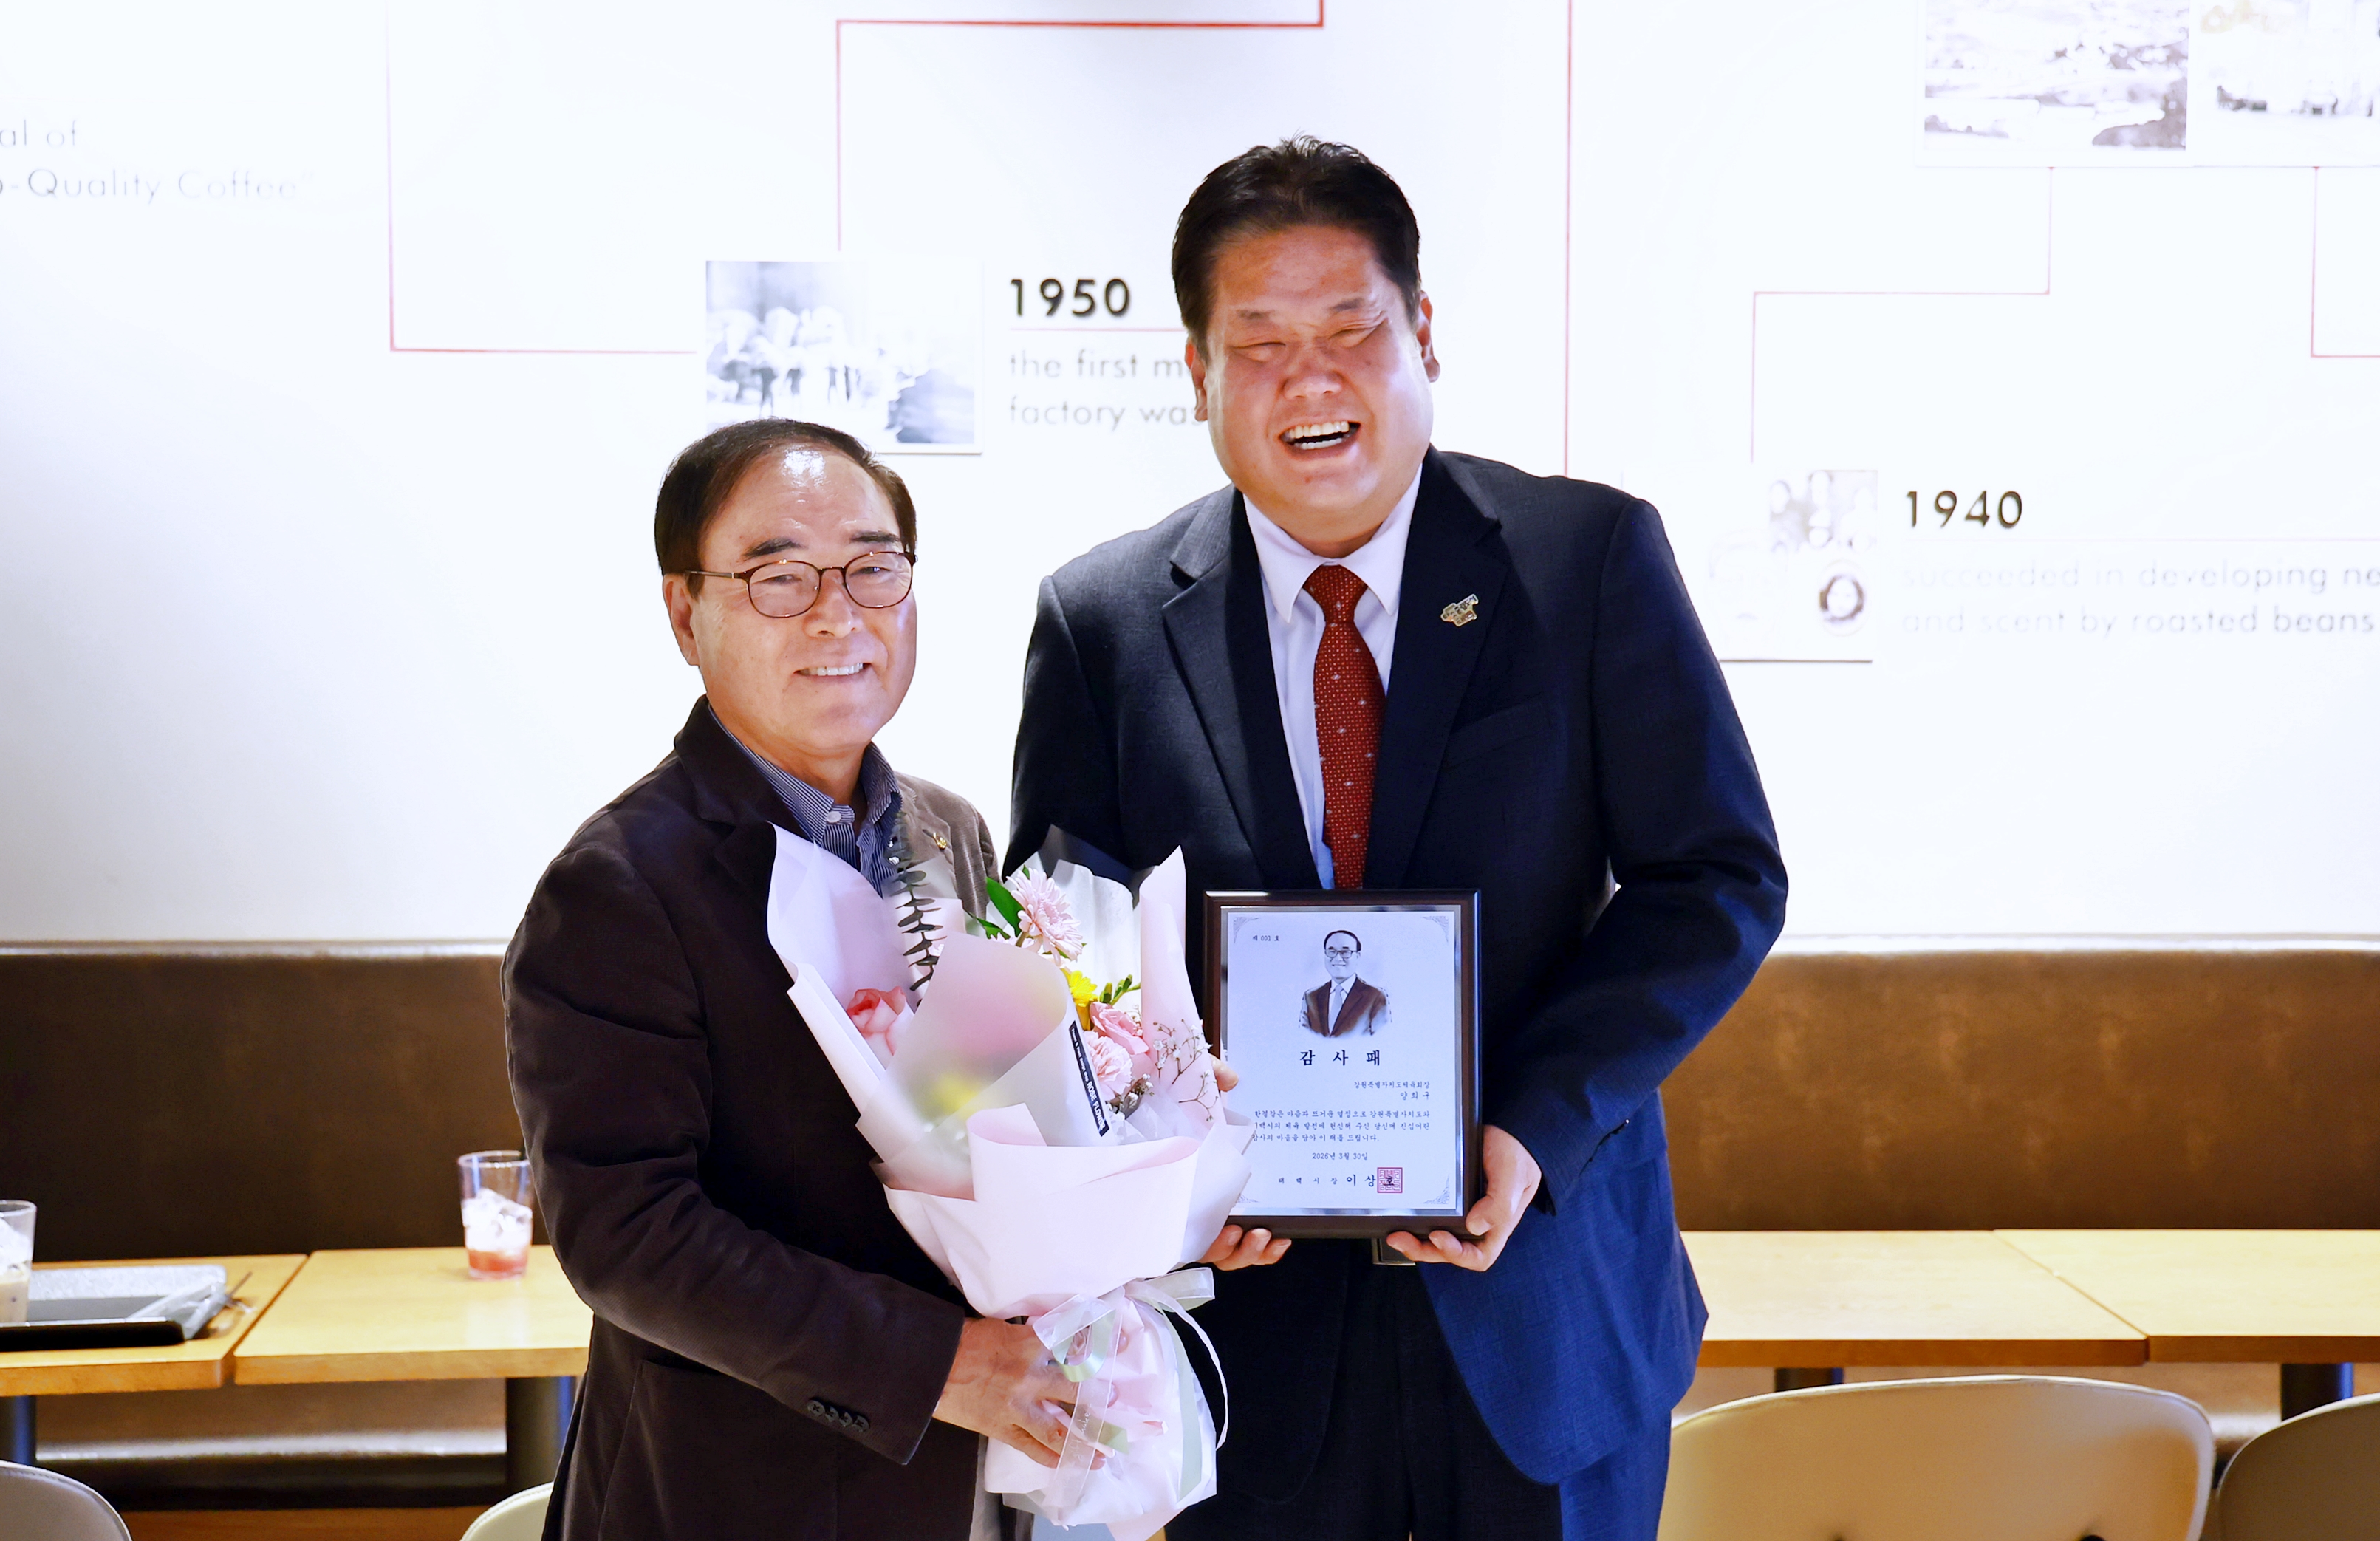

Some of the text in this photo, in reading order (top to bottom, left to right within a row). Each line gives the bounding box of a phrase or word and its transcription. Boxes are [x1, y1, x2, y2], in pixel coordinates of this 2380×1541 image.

[46, 119, 78, 148] of
[1010, 278, 1132, 318] 1950
[1011, 347, 1191, 378] the first m
[1011, 394, 1126, 432] factory
[1906, 490, 2023, 529] 1940
[1901, 559, 2080, 588] succeeded
[2096, 559, 2124, 587] in
[2138, 558, 2328, 595] developing
[1901, 604, 2375, 640] and scent by roasted beans
[1300, 1049, 1380, 1066] 감 사 패
[1087, 1081, 1098, 1101] ROSE
[1093, 1101, 1106, 1130] FLOWER
[1287, 1110, 1309, 1118] 마음과
[1312, 1110, 1333, 1118] 뜨거운
[1337, 1110, 1367, 1118] 열정으로
[1276, 1134, 1299, 1142] 마음을
[1319, 1134, 1326, 1142] 이
[1347, 1134, 1379, 1142] 드립니다.
[1355, 1121, 1369, 1130] 주신
[1400, 1122, 1429, 1130] 진심어린
[1312, 1152, 1368, 1161] 2026년 3월 30일
